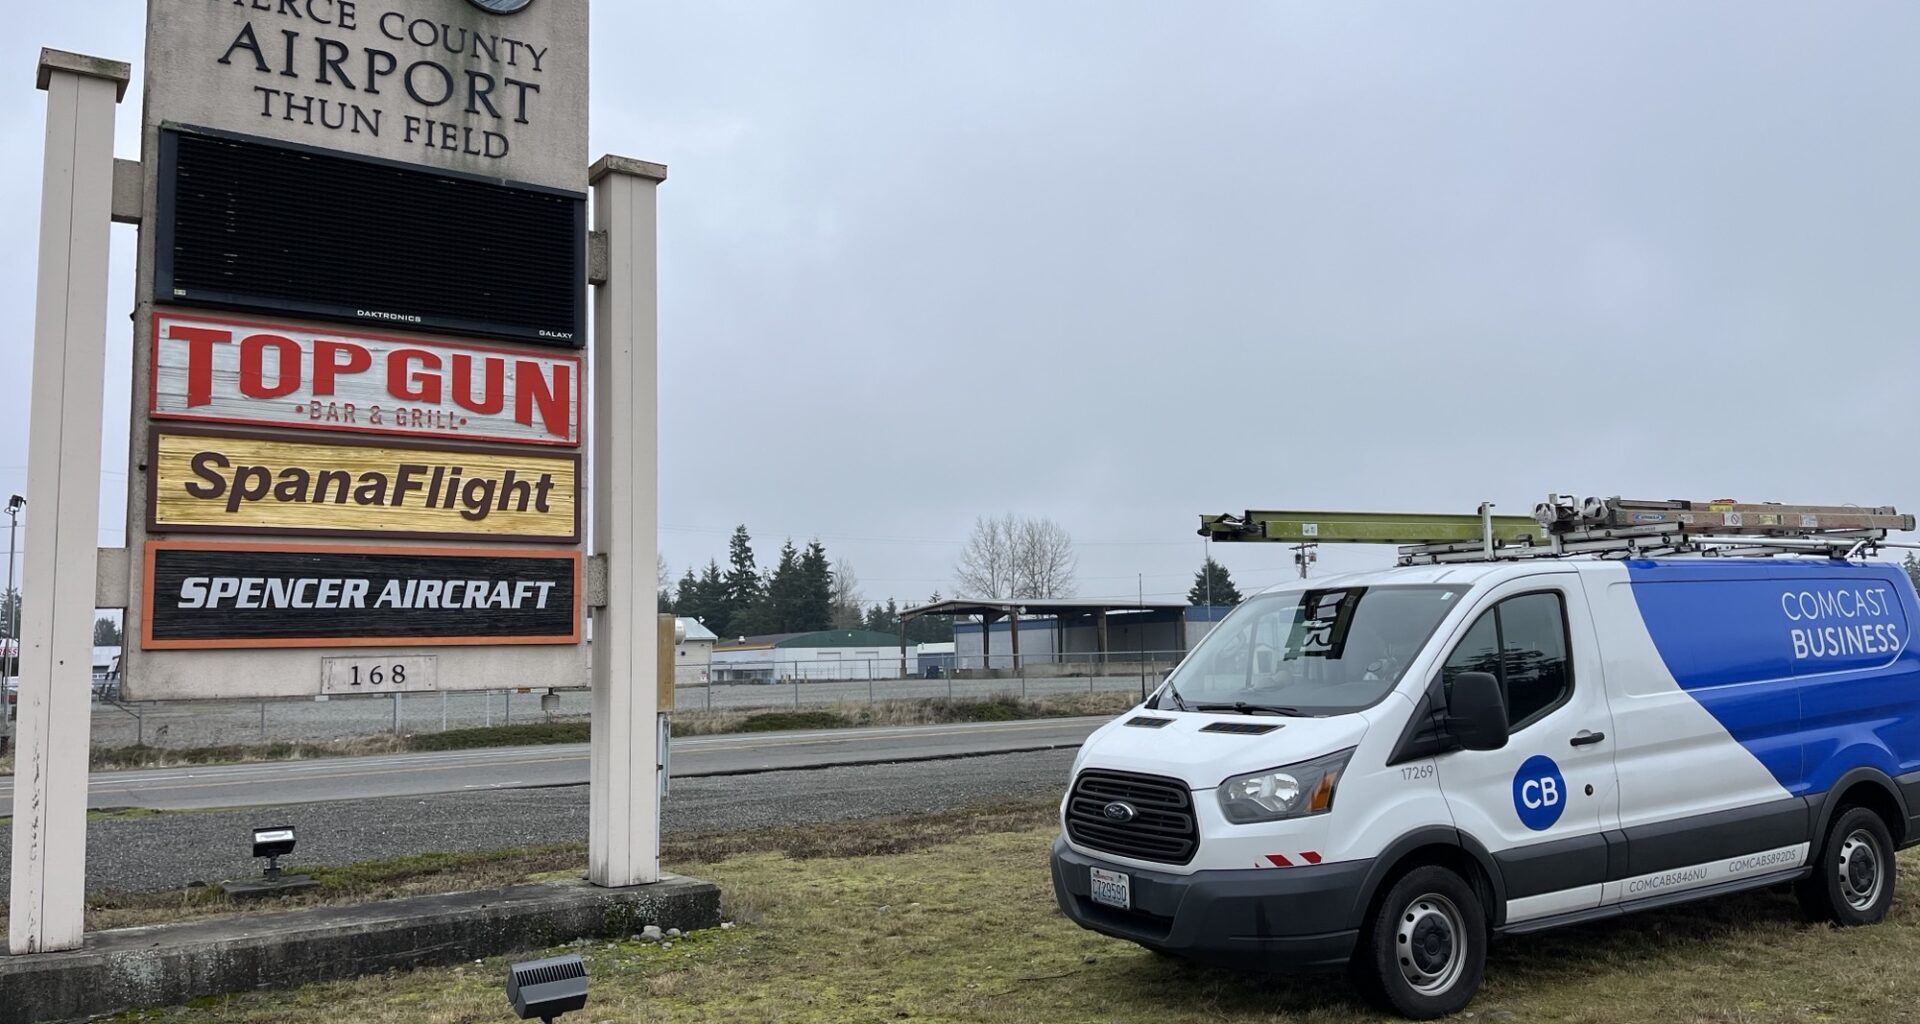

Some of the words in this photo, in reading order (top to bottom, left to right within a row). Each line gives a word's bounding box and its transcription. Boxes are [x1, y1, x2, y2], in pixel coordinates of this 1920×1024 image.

[379, 12, 549, 72] COUNTY
[217, 21, 541, 125] AIRPORT
[254, 86, 382, 137] THUN
[403, 115, 510, 160] FIELD
[356, 309, 422, 323] DAKTRONICS
[538, 329, 573, 340] GALAXY
[169, 325, 373, 409] TOP
[386, 348, 571, 441] GUN
[309, 400, 356, 424] BAR
[368, 405, 383, 425] &
[395, 406, 459, 431] GRILL
[184, 451, 555, 521] SpanaFlight
[177, 576, 370, 609] SPENCER
[373, 579, 556, 609] AIRCRAFT
[1782, 588, 1889, 620] COMCAST
[1790, 623, 1900, 659] BUSINESS
[349, 664, 407, 687] 168
[1401, 765, 1433, 781] 17269
[1522, 776, 1558, 809] CB
[1629, 867, 1708, 894] COMCABS846NU
[1728, 849, 1797, 873] COMCABS892DS
